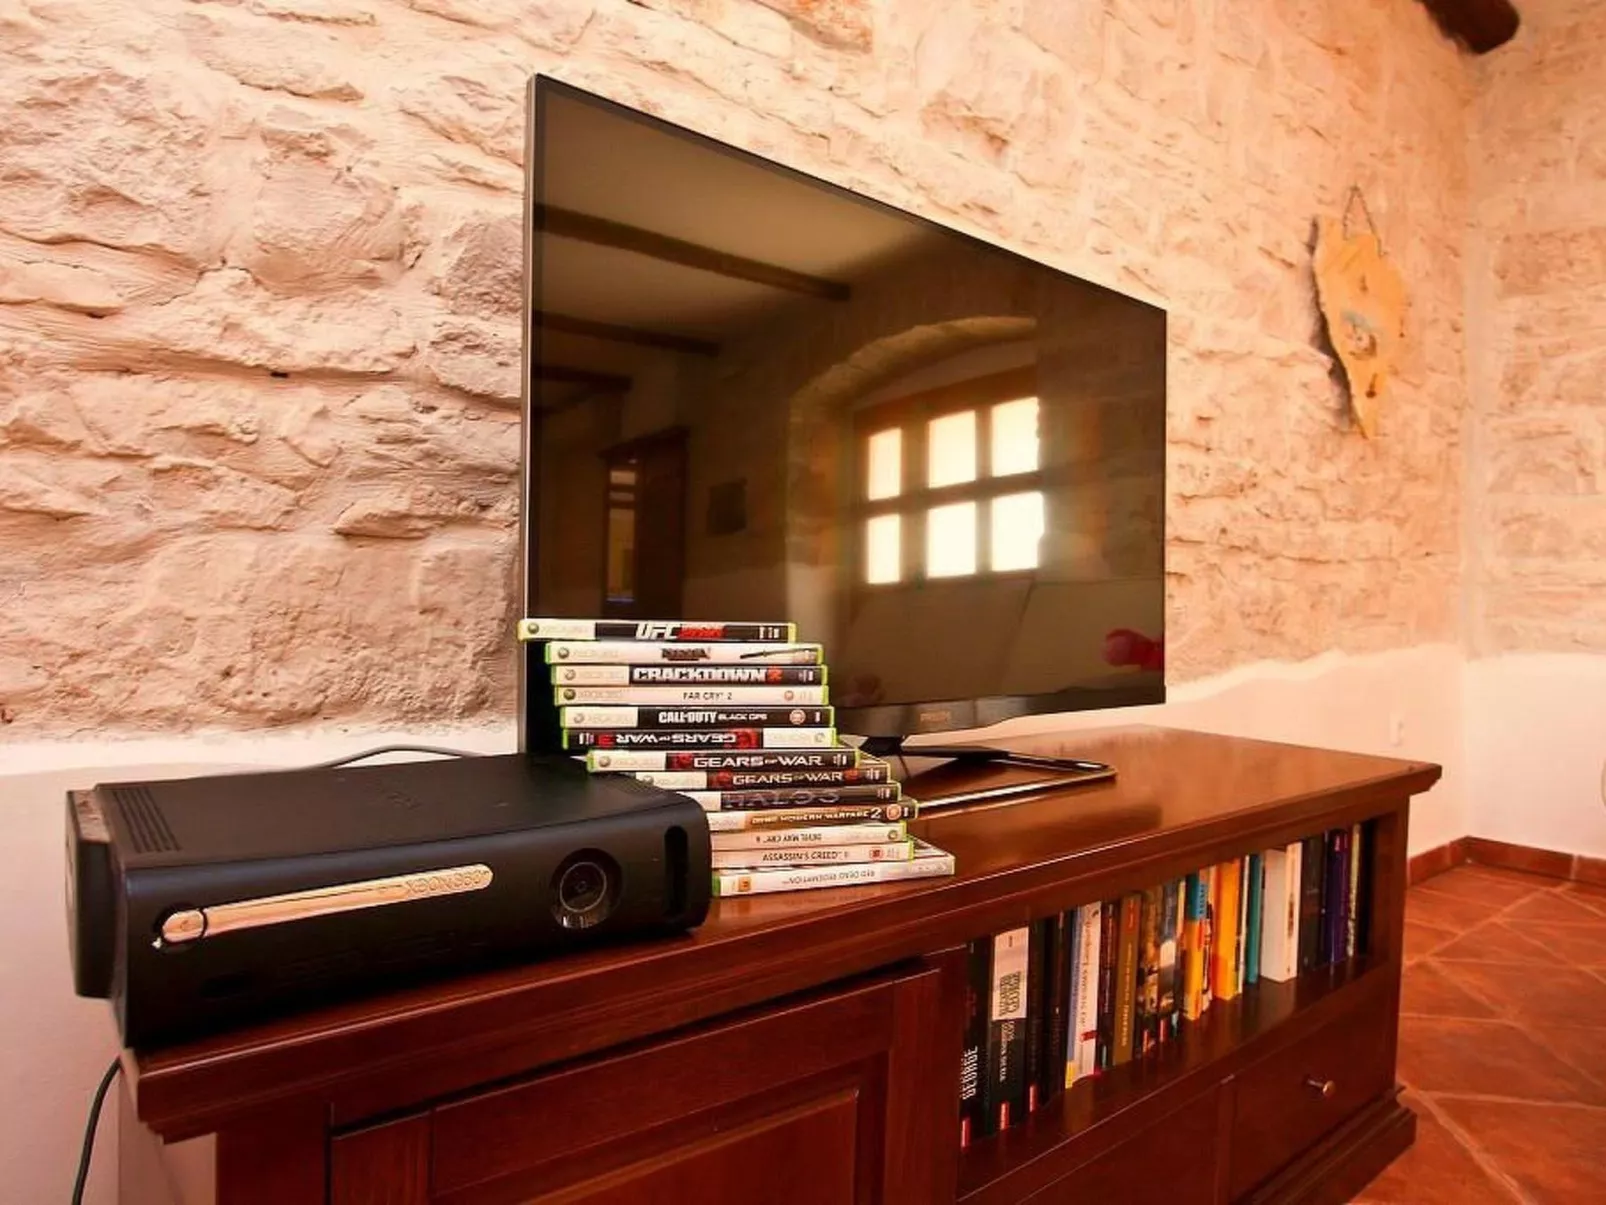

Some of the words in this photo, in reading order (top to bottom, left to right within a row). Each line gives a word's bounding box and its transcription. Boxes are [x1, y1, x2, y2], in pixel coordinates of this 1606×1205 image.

[635, 623, 681, 640] UFC
[633, 667, 767, 682] CRACKDOWN
[683, 691, 700, 699] FAR
[702, 691, 720, 699] CRY
[659, 711, 685, 723] CALL
[687, 711, 717, 723] DUTY
[616, 733, 655, 744] WAR
[671, 733, 736, 744] GEARS
[693, 757, 764, 768] GEARS
[773, 756, 823, 766] WAR
[733, 773, 792, 785] GEARS
[803, 771, 842, 782] WAR
[870, 807, 881, 819] 2
[763, 852, 810, 861] ASSASSIN'S
